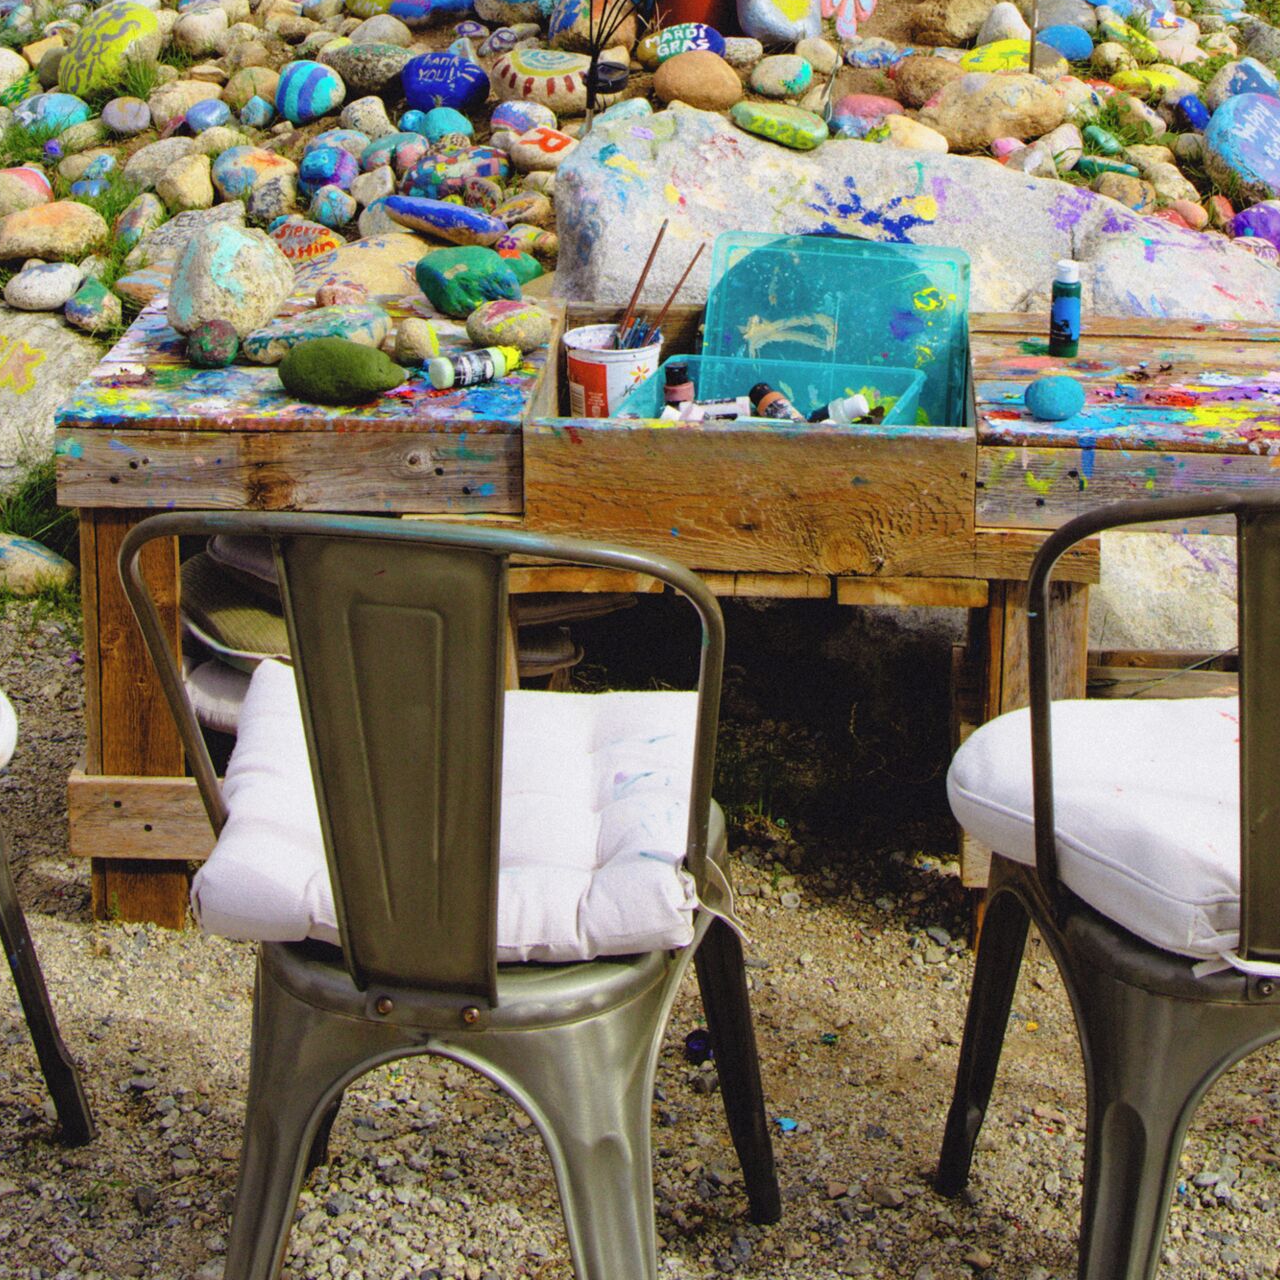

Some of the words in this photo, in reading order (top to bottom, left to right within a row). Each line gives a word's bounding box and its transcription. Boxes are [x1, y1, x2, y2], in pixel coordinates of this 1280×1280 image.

[645, 28, 705, 48] MARDI
[656, 39, 710, 57] GRAS
[1231, 101, 1280, 143] Happy
[274, 223, 331, 239] Sierra
[278, 241, 336, 259] ustin
[497, 234, 520, 250] 25
